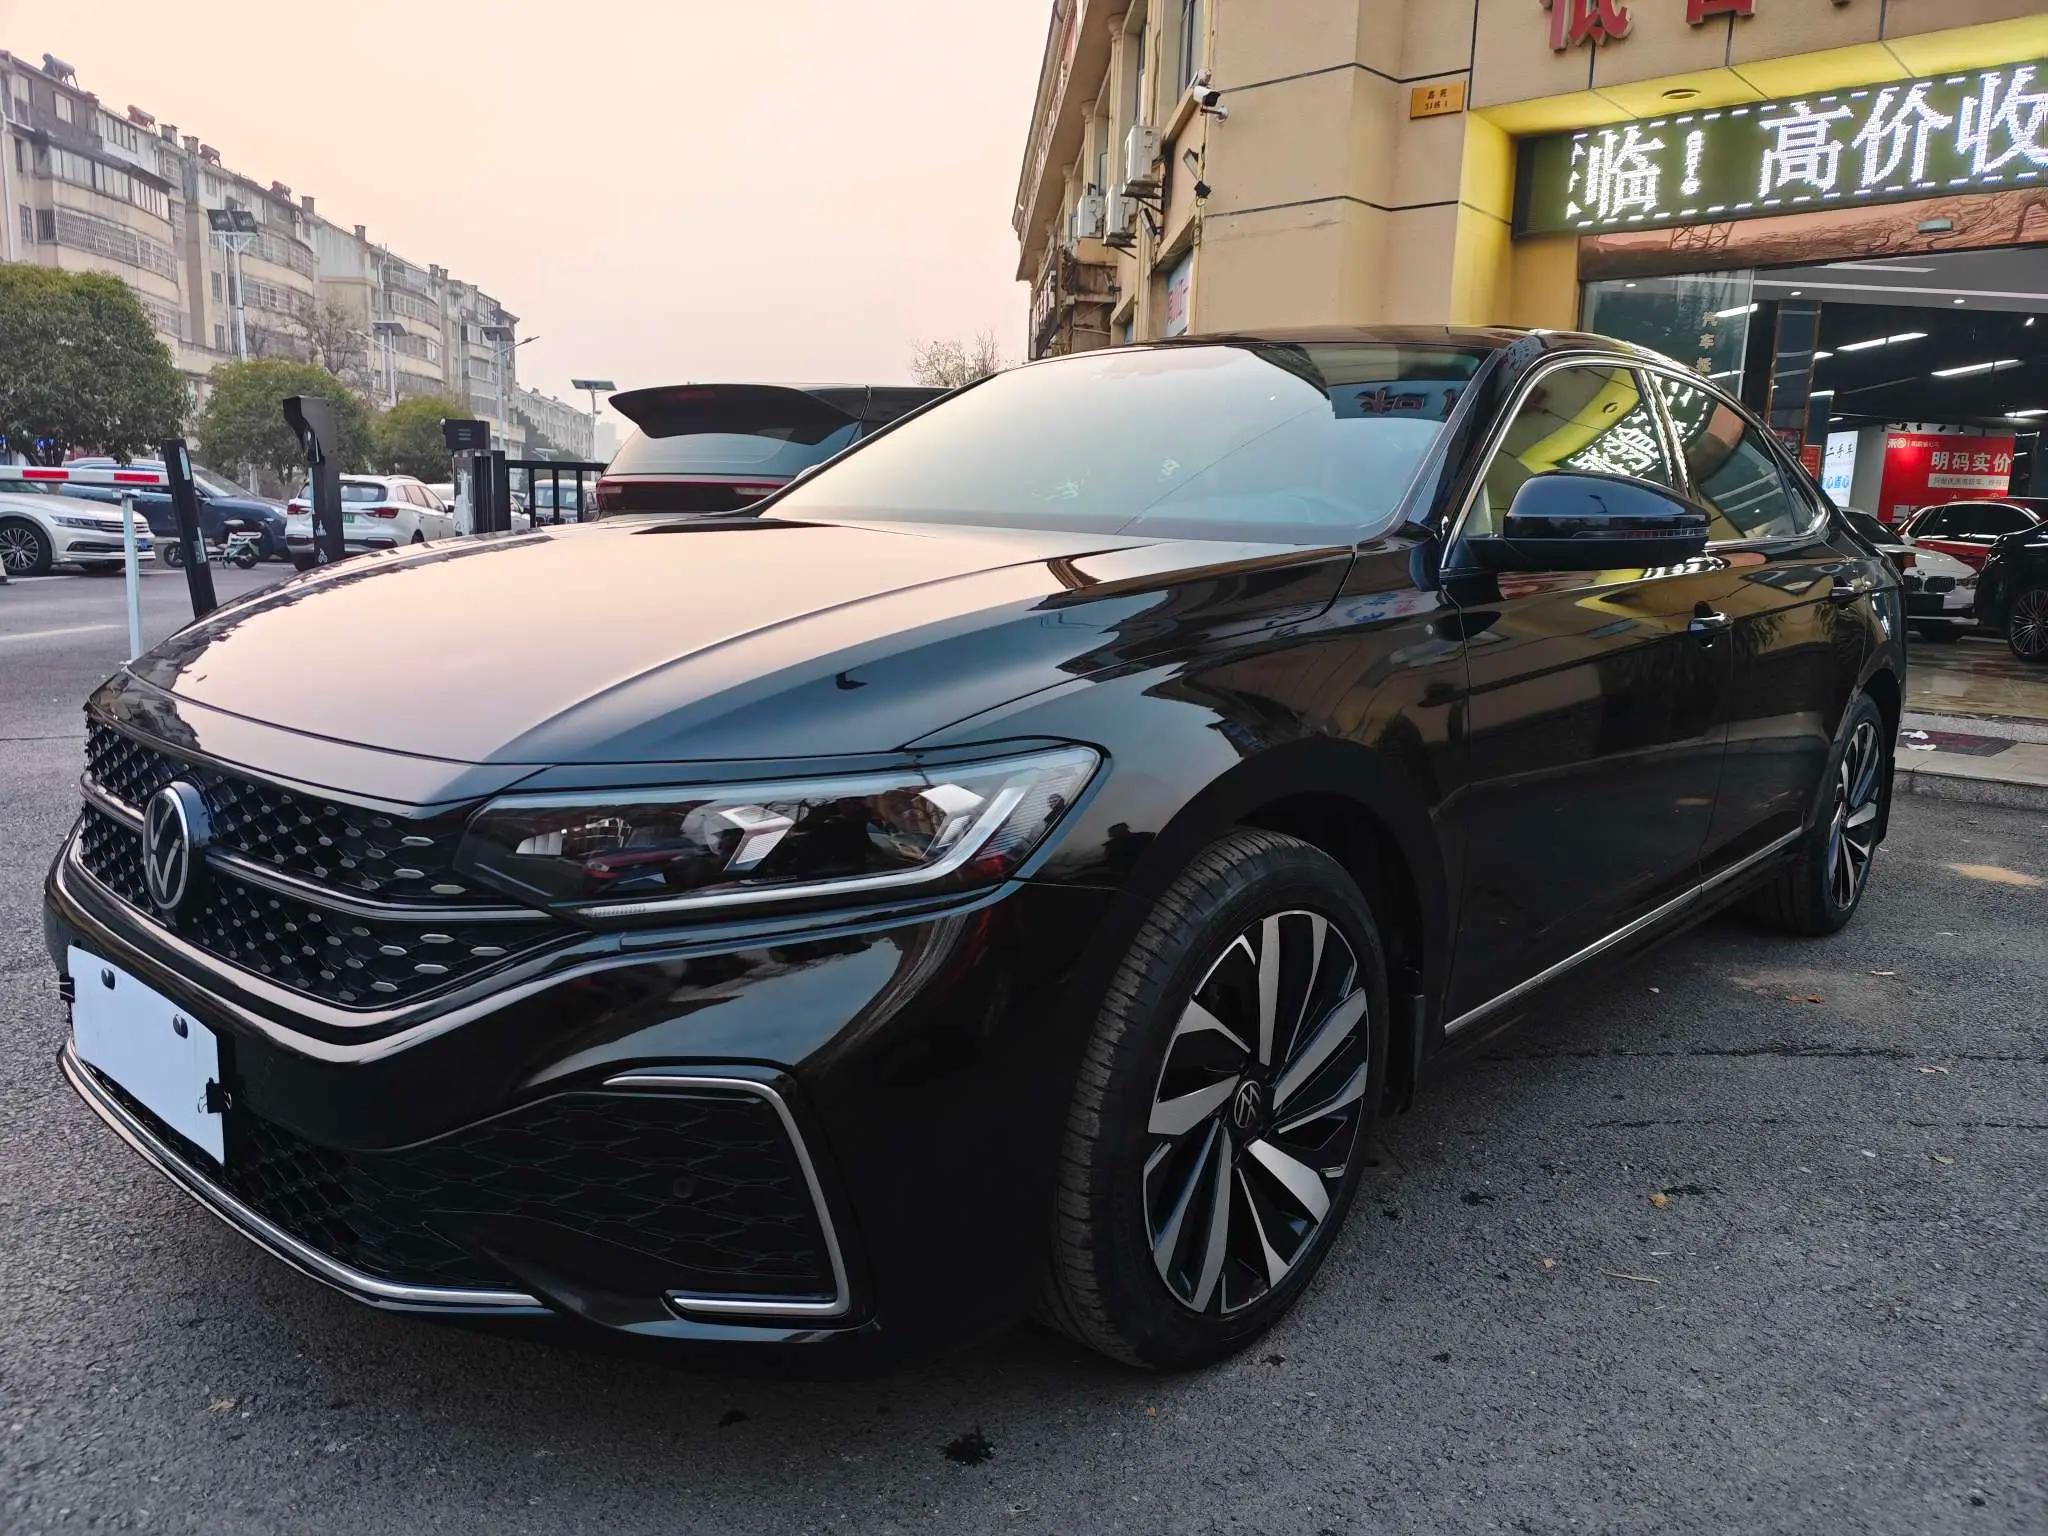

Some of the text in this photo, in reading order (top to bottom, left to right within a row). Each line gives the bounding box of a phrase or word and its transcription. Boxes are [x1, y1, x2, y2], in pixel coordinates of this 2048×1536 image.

[1758, 66, 2048, 198] 高价收
[1931, 451, 2011, 473] 明码实价
